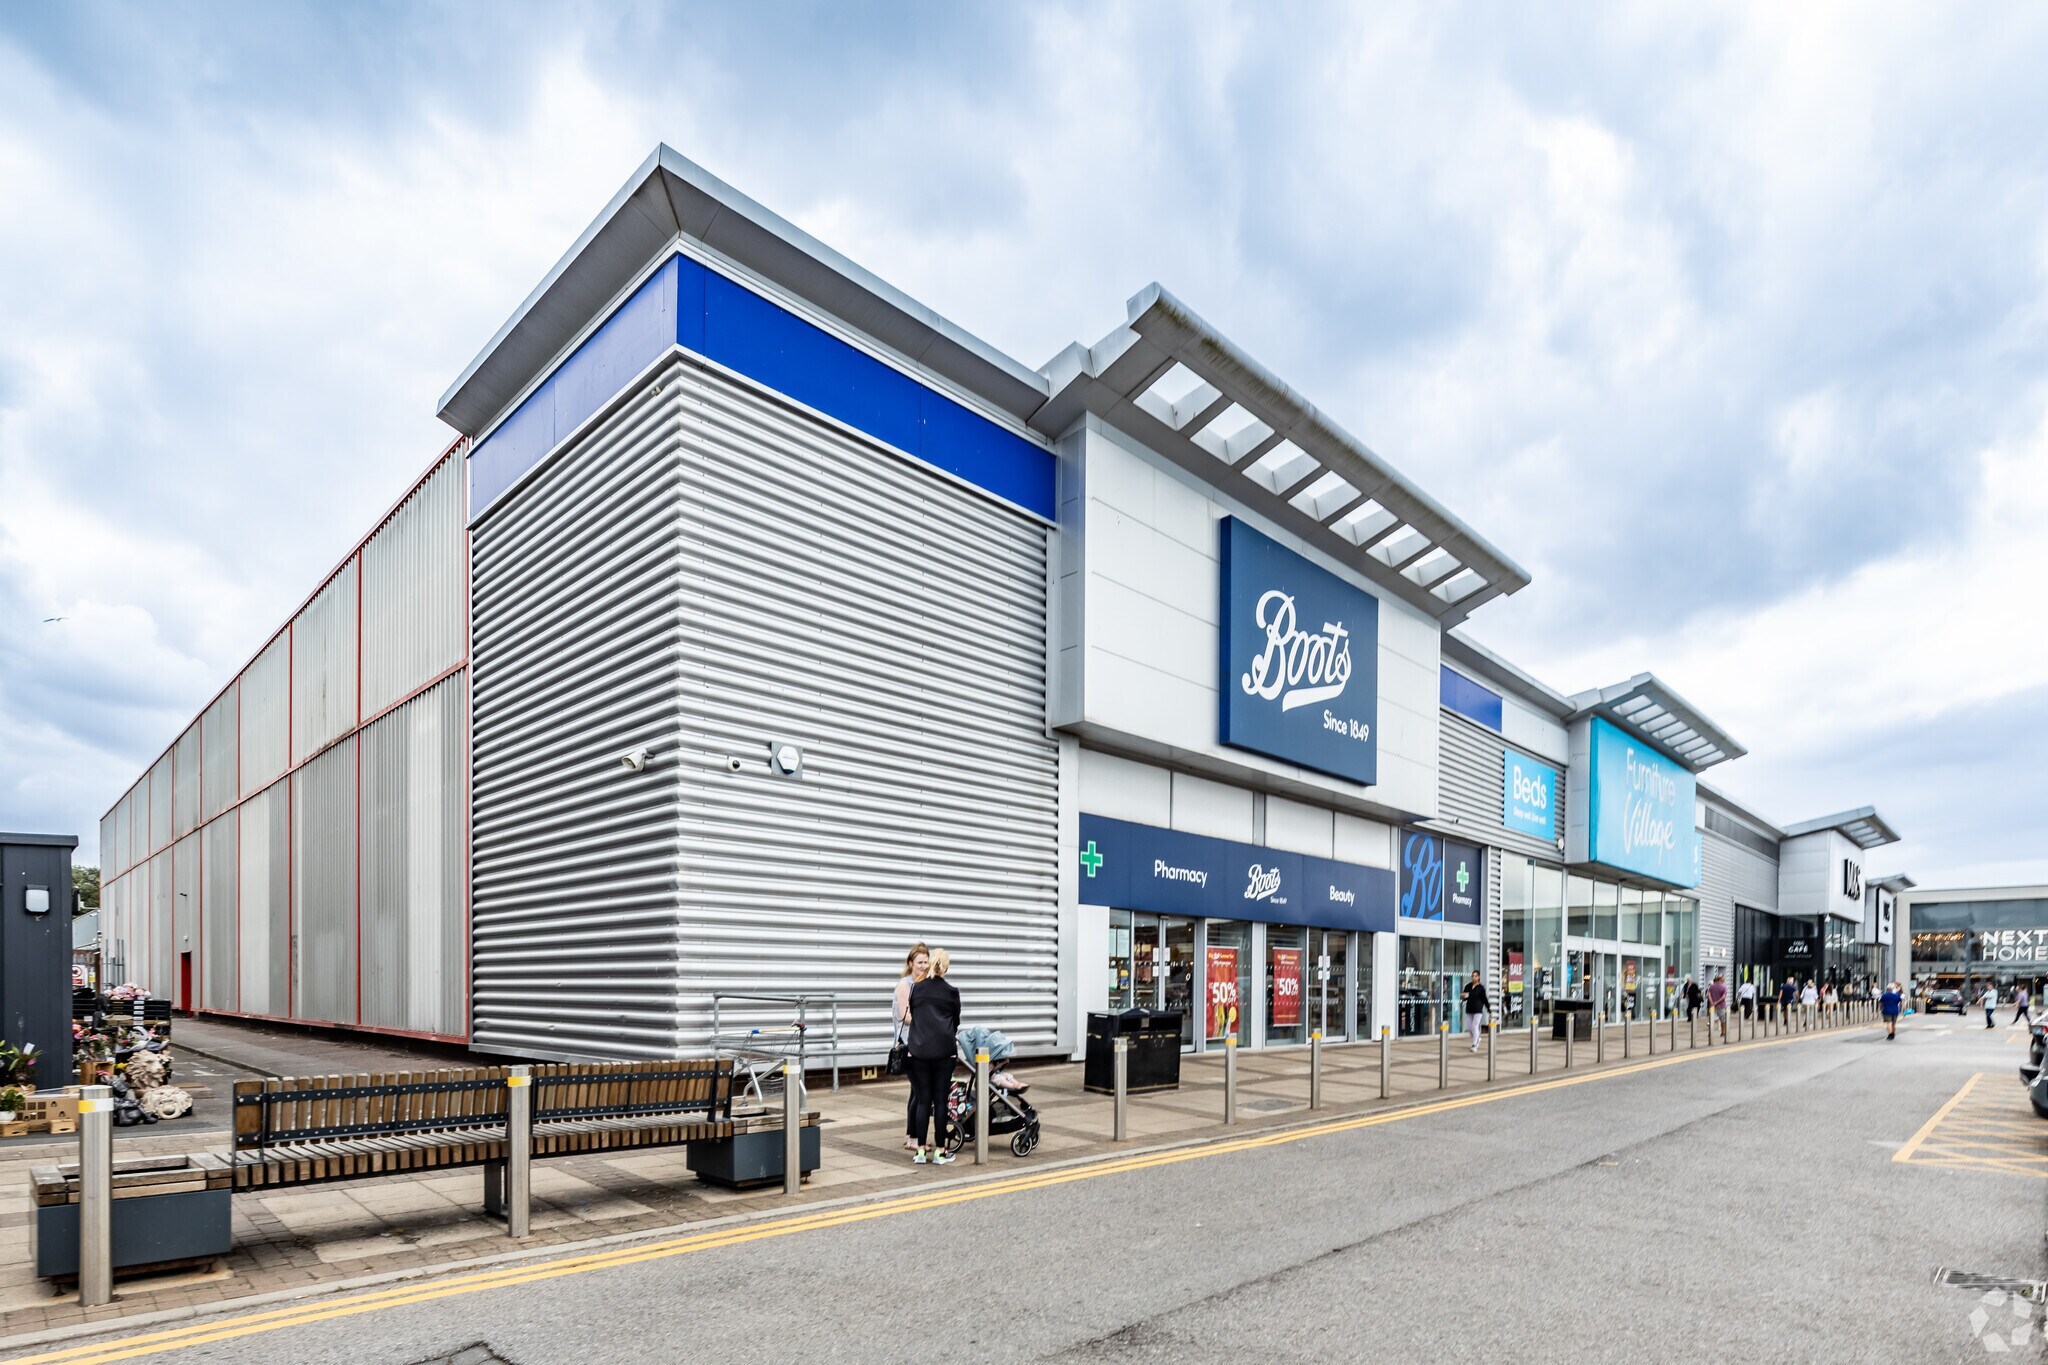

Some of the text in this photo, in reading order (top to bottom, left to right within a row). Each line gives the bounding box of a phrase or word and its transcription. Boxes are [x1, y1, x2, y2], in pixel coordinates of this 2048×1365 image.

[1241, 589, 1352, 712] Boots
[1323, 709, 1369, 743] Since 1849
[1513, 764, 1547, 810] Beds
[1625, 747, 1676, 804] Furniture
[1623, 792, 1676, 865] Village
[1154, 859, 1208, 888] Pharmacy
[1244, 863, 1281, 901] Boots
[1329, 885, 1355, 907] Beauty
[1452, 892, 1473, 909] Pharmacy
[1982, 929, 2048, 946] NEXT
[1982, 945, 2048, 961] HOME
[1509, 963, 1523, 976] SALE
[1212, 981, 1237, 1004] 50%
[1279, 977, 1299, 996] 50%
